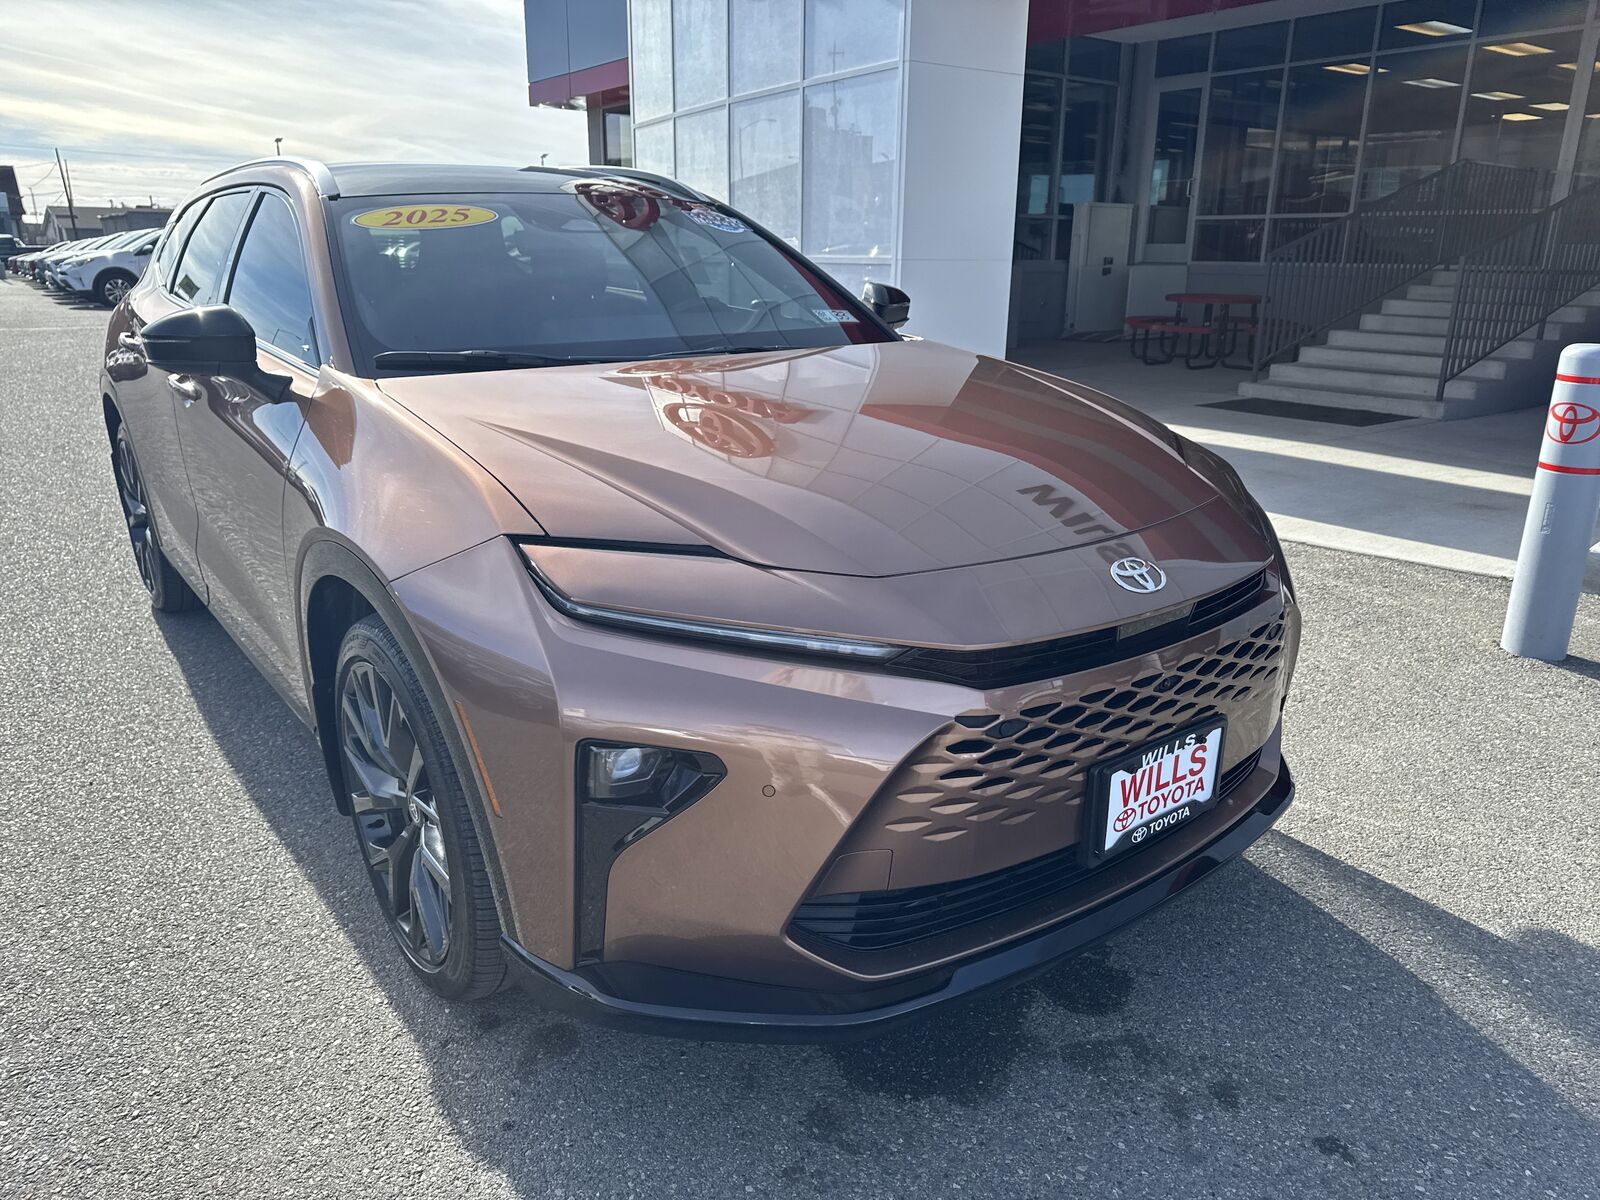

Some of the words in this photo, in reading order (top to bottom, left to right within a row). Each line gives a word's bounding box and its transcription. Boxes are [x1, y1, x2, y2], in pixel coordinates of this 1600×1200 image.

[382, 208, 470, 226] 2025
[1142, 733, 1196, 767] WILLS
[1120, 744, 1208, 808] WILLS
[1138, 776, 1205, 819] TOYOTA
[1149, 806, 1190, 834] TOYOTA
